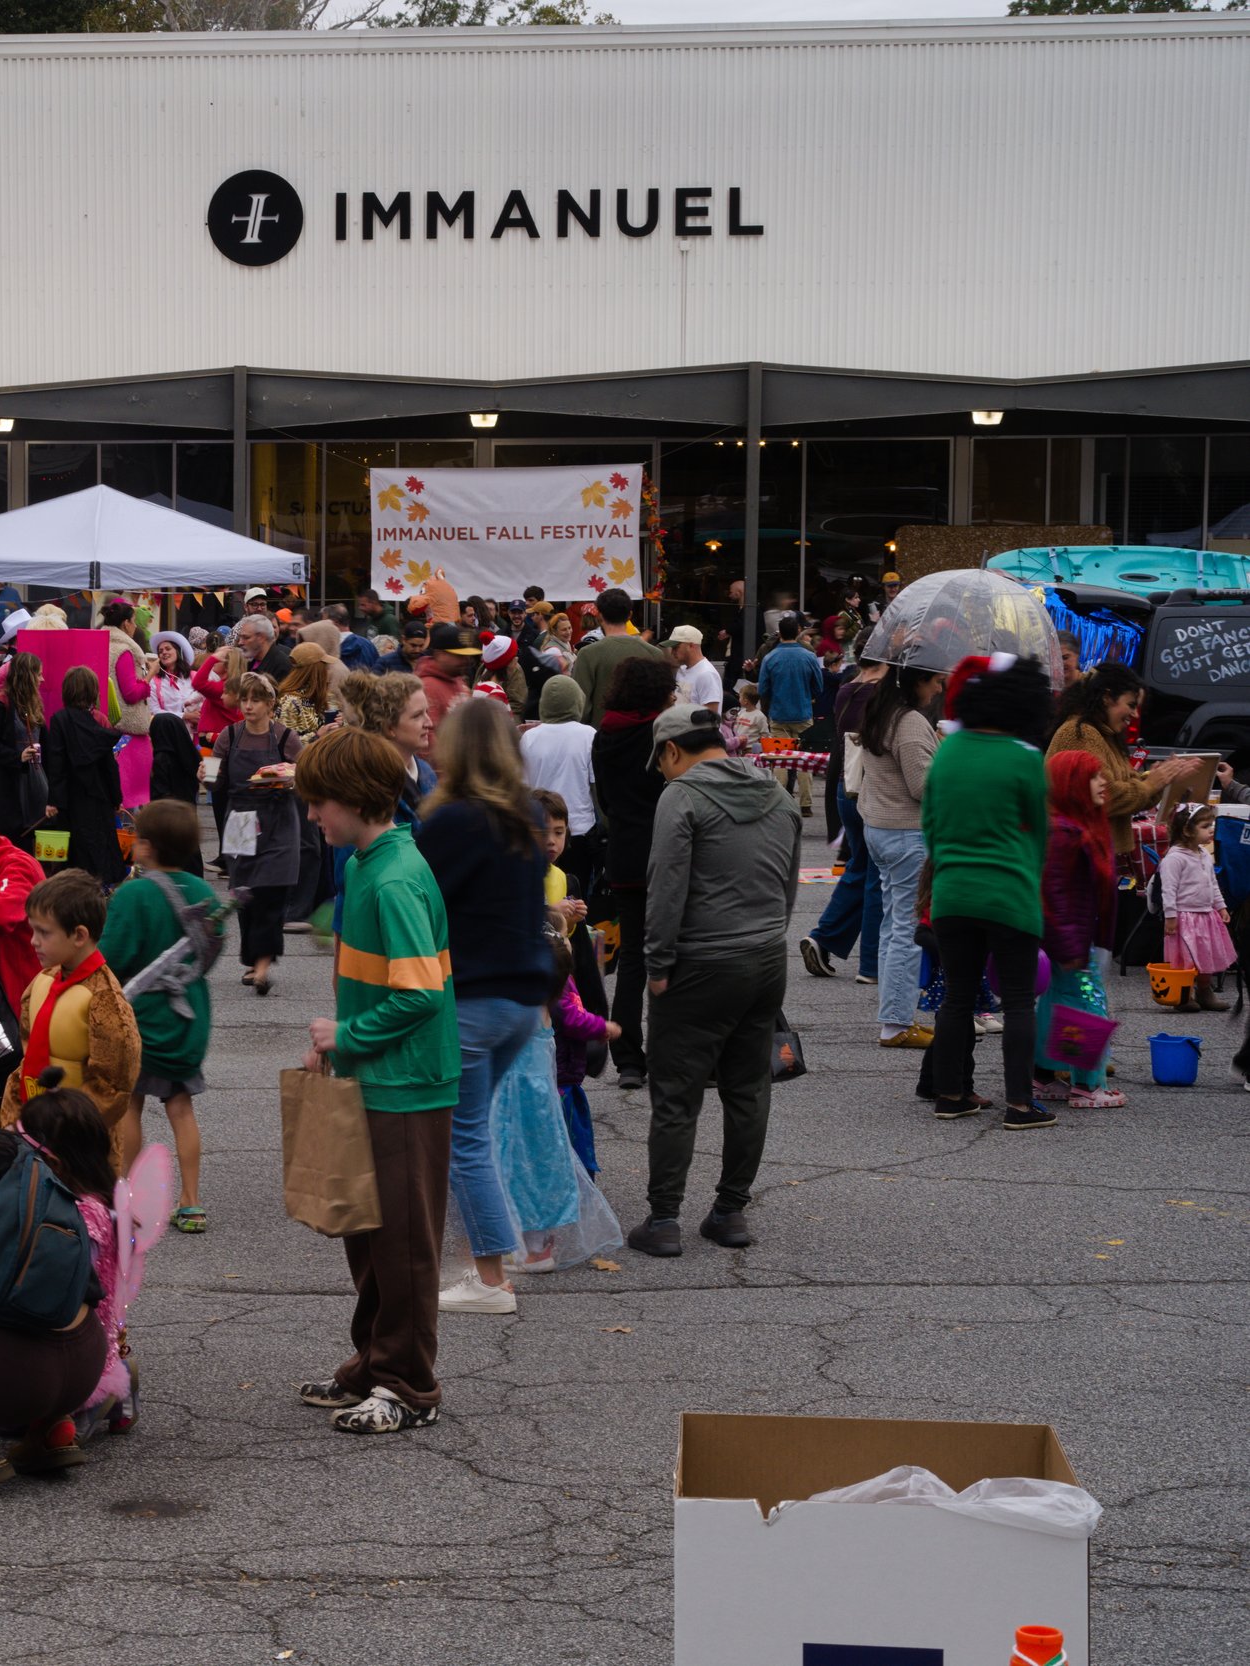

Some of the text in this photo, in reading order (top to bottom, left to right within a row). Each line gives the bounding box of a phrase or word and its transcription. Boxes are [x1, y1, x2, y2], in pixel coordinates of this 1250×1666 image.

[336, 187, 764, 241] IMMANUEL
[377, 524, 634, 541] IMMANUEL FALL FESTIVAL
[1160, 642, 1194, 664] GET
[1169, 653, 1213, 679] JUST
